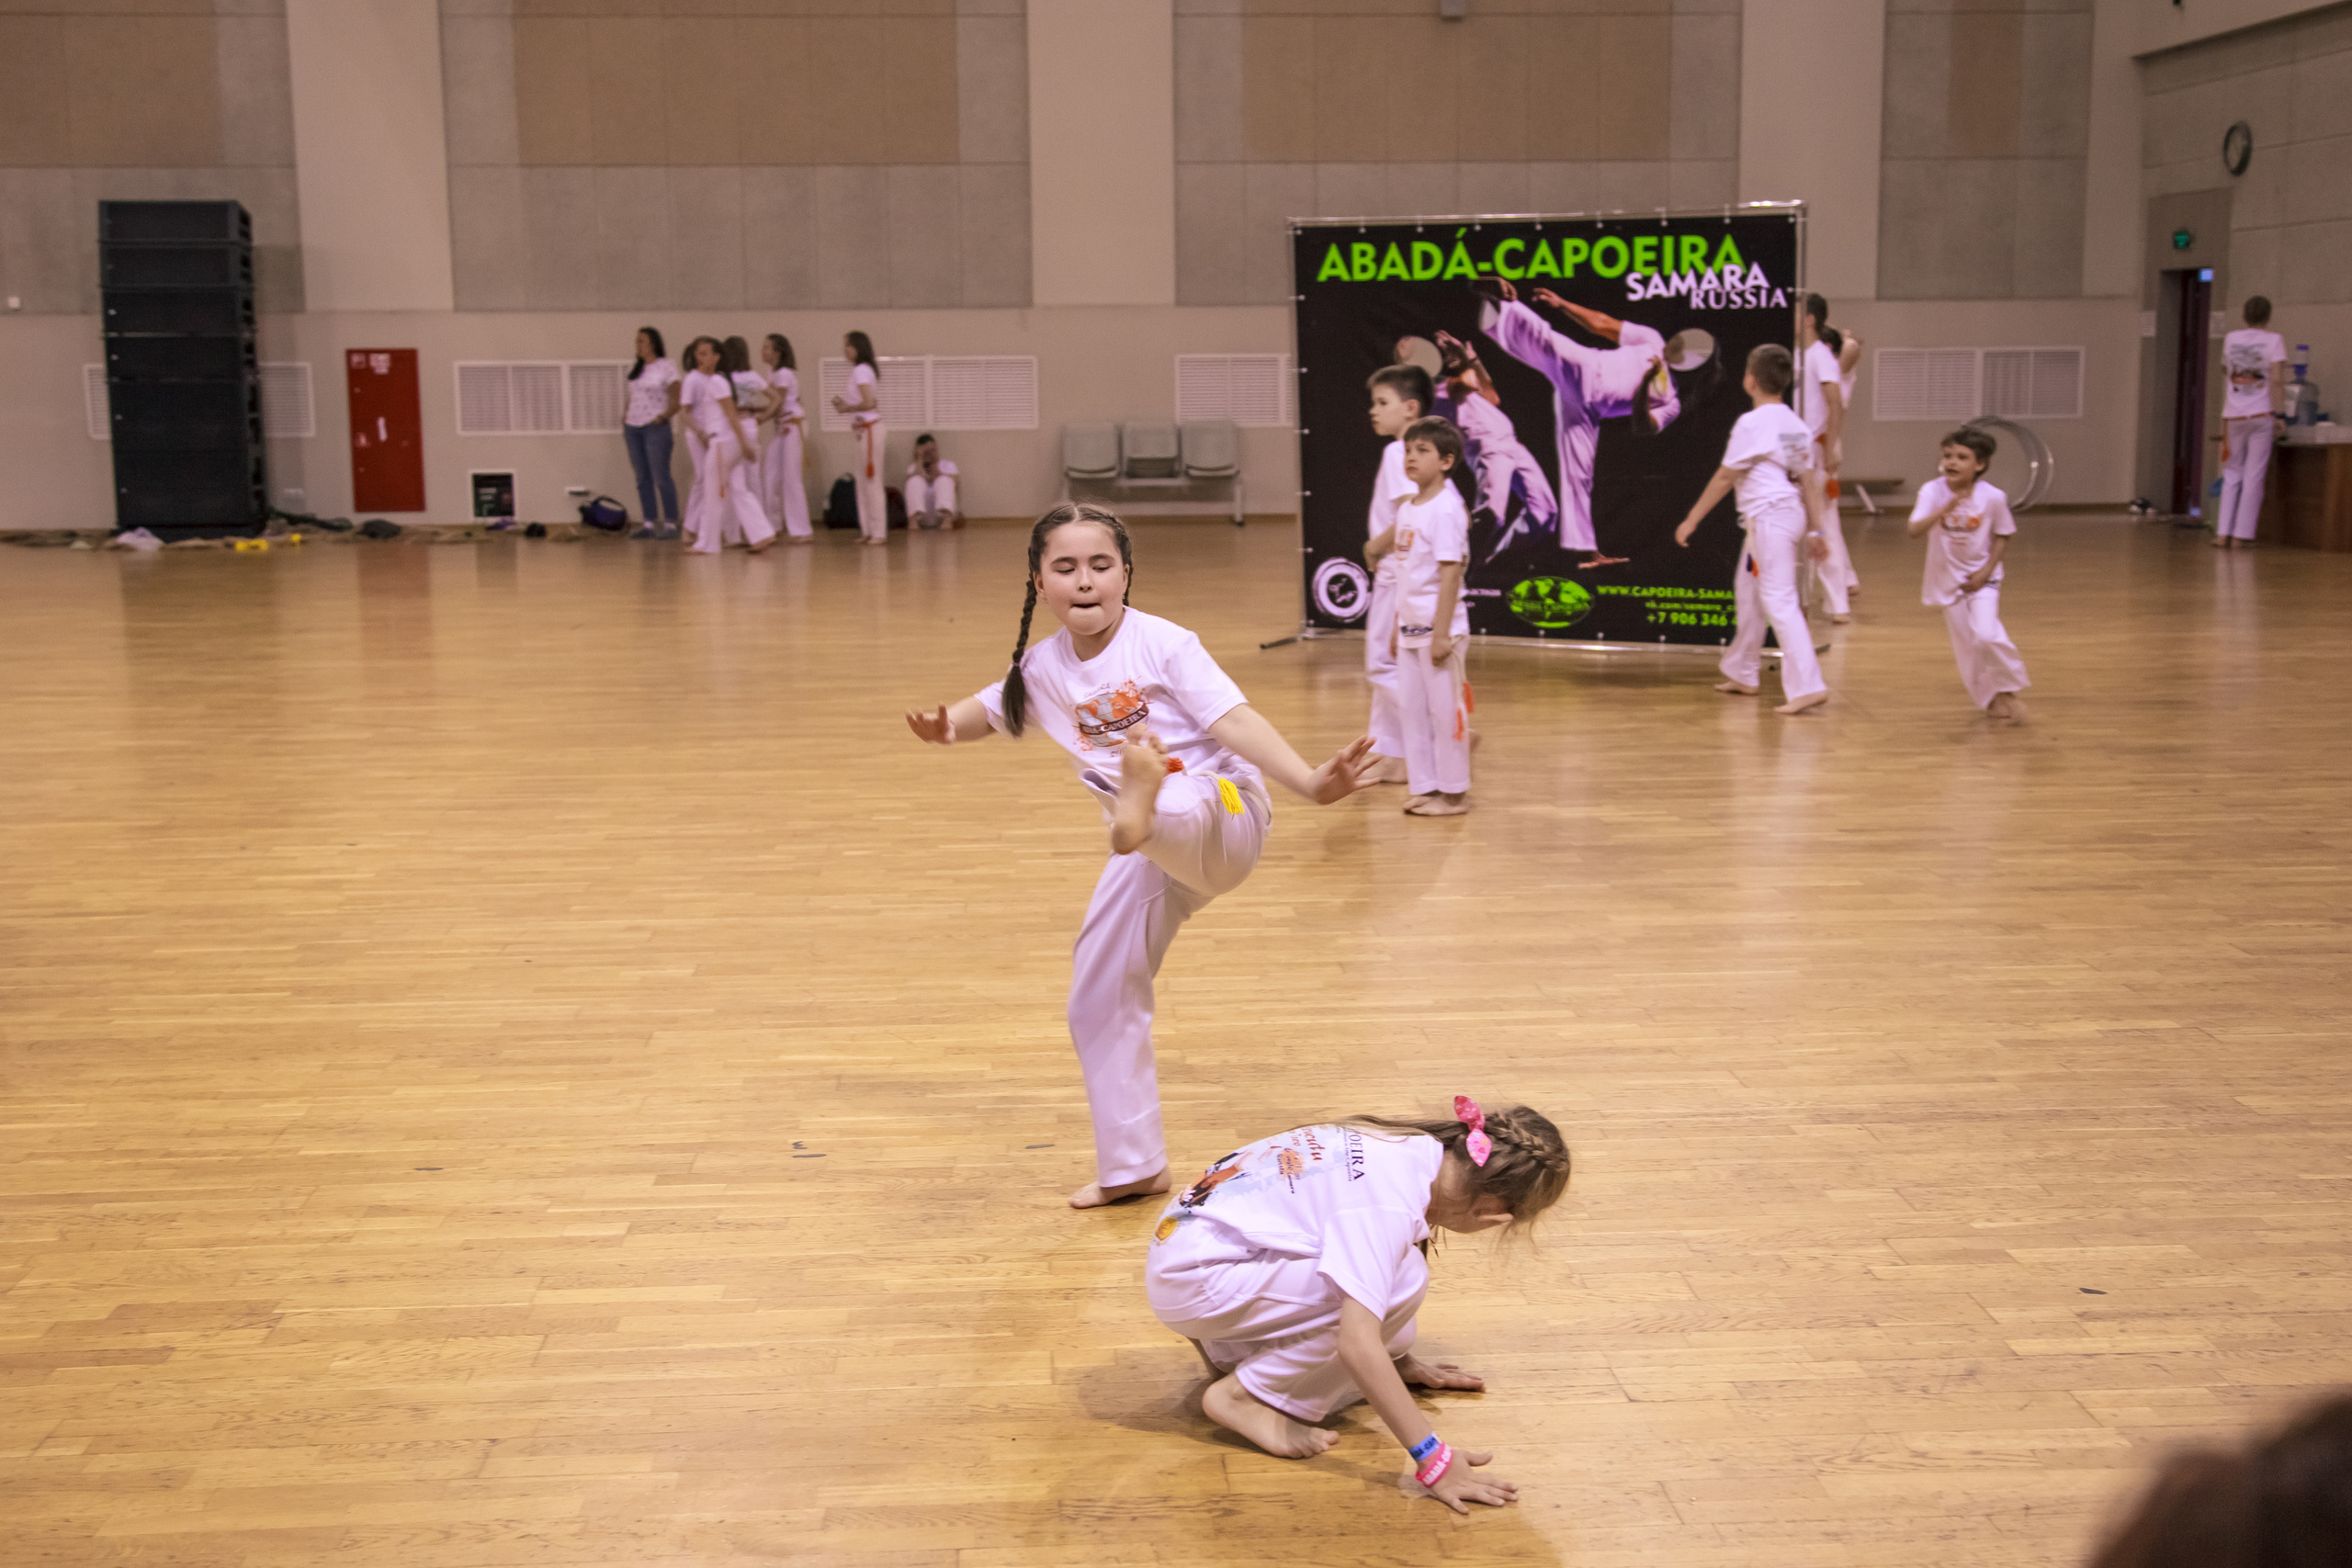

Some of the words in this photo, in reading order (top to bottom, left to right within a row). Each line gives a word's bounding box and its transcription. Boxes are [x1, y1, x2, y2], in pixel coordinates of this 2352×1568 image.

[1317, 227, 1747, 282] ABADÁ-CAPOEIRA
[1626, 261, 1770, 301] SAMARA
[1690, 288, 1788, 310] RUSSIA
[1701, 614, 1727, 626] 346
